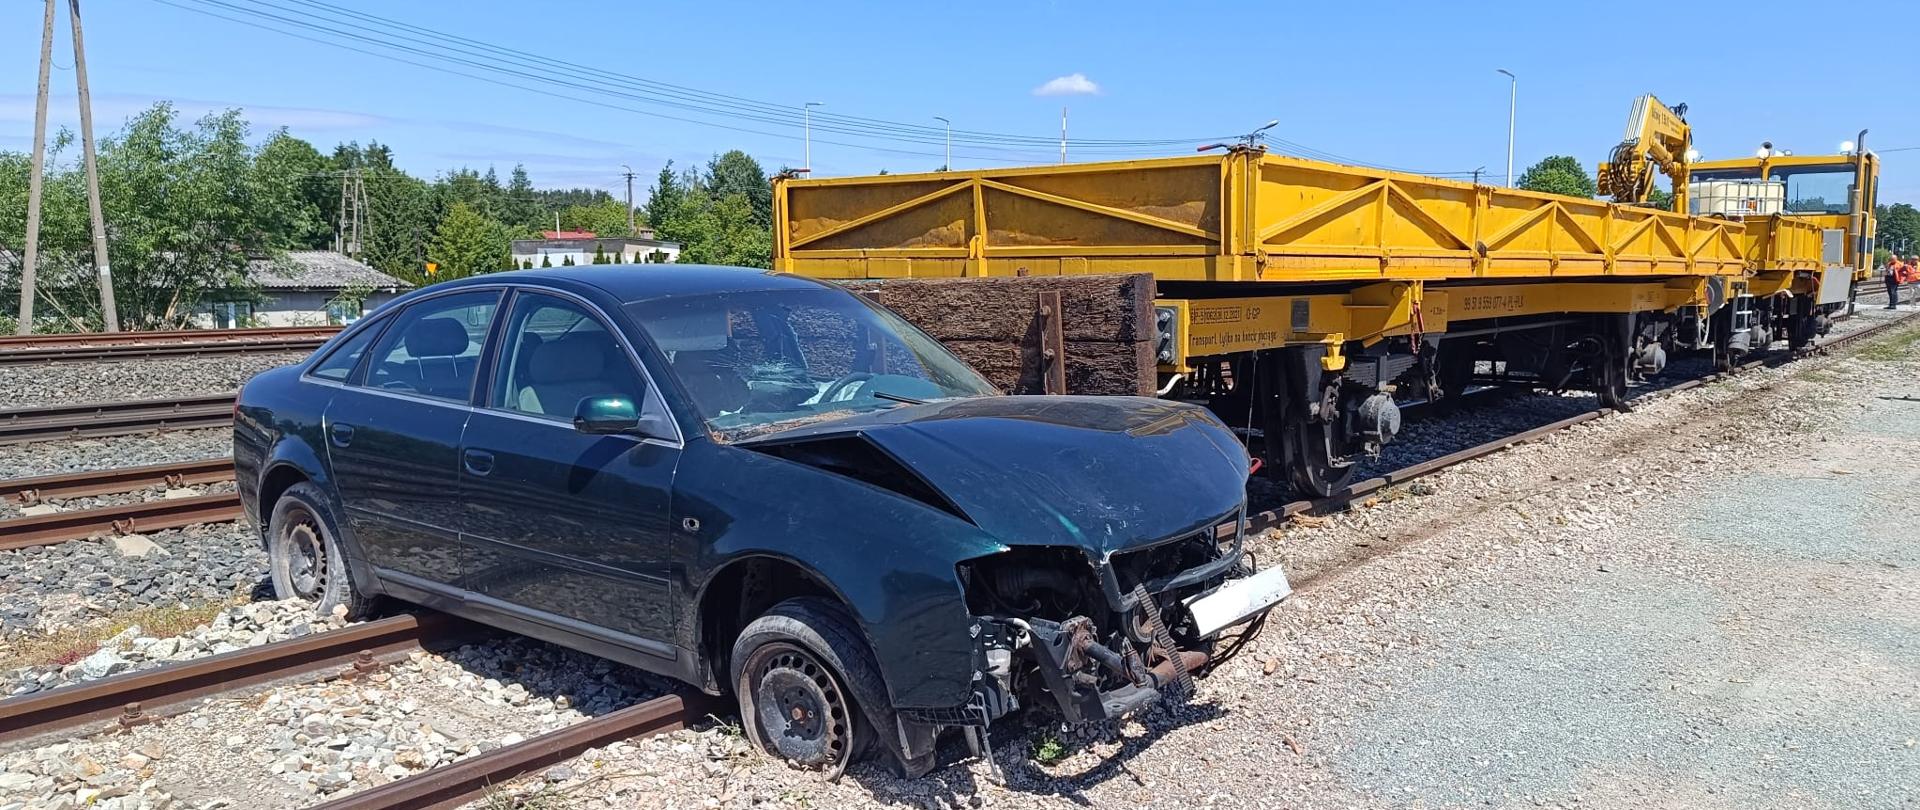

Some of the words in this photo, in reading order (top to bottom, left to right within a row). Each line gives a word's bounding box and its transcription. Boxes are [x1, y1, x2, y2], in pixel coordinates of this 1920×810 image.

[1188, 332, 1217, 348] Transport
[1219, 331, 1234, 347] tylko
[1235, 333, 1241, 343] na
